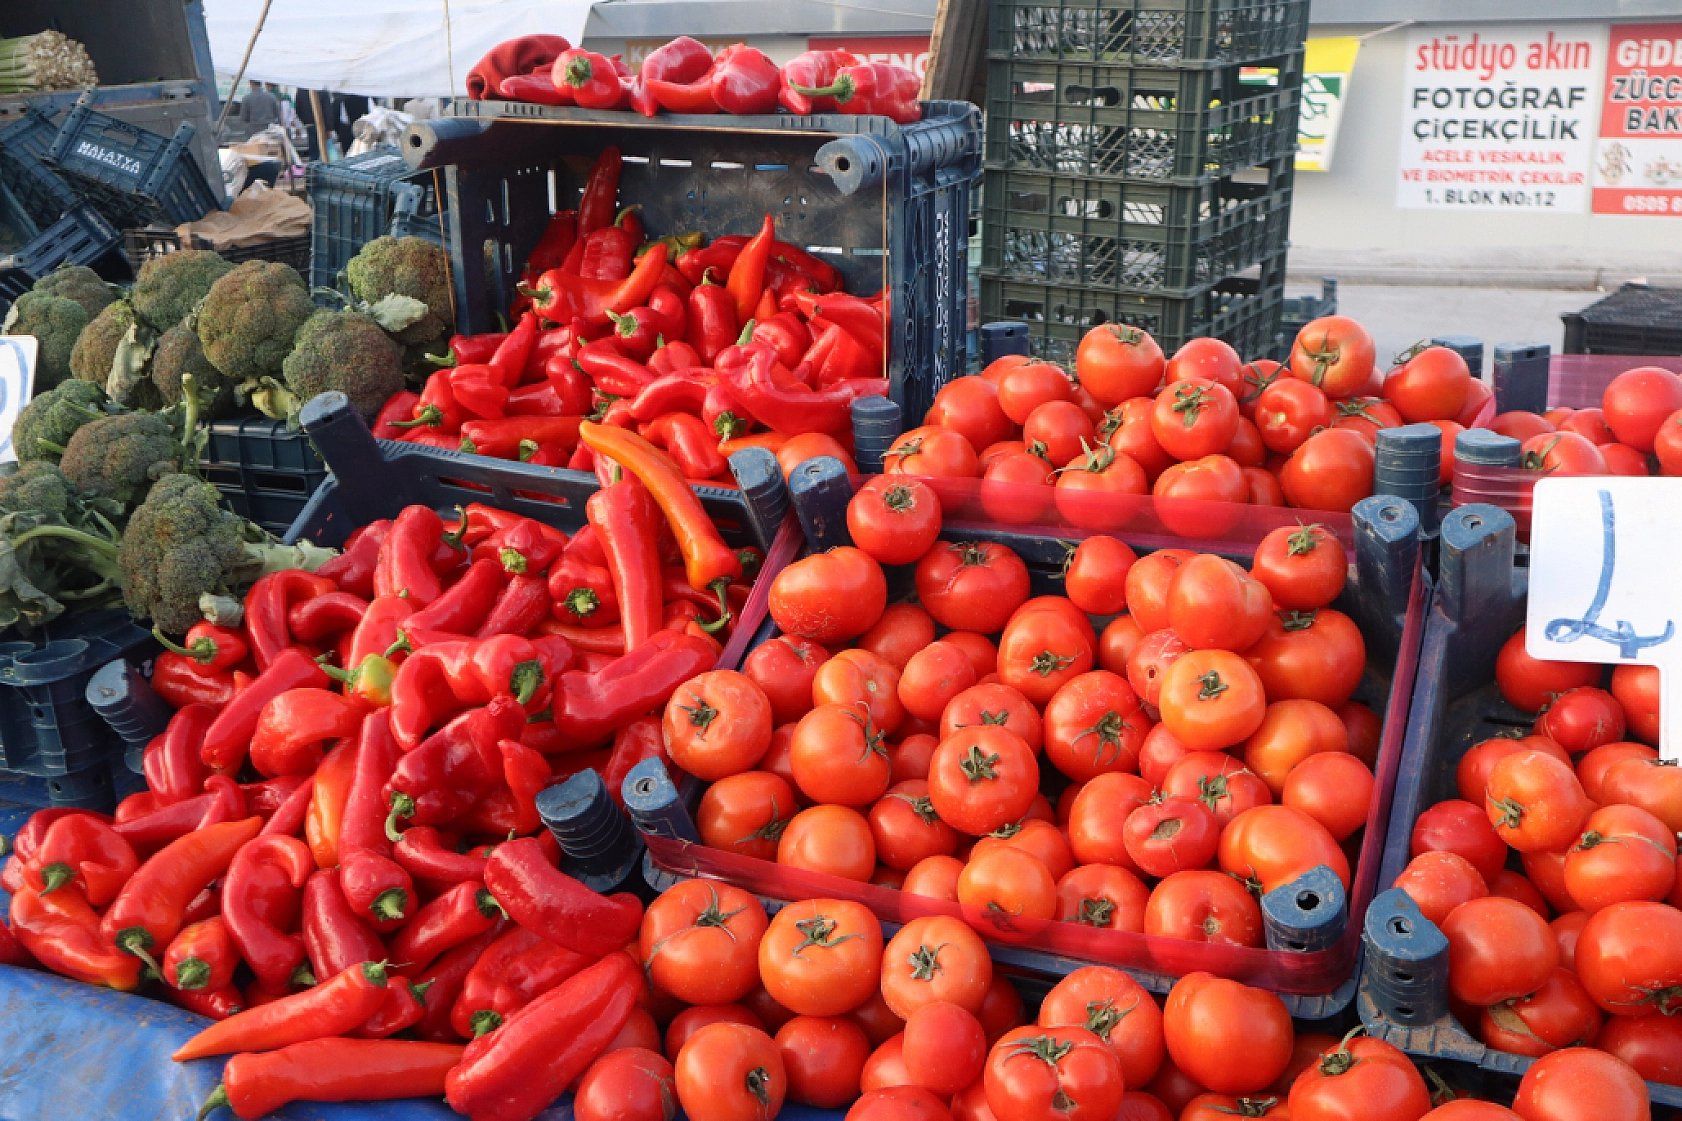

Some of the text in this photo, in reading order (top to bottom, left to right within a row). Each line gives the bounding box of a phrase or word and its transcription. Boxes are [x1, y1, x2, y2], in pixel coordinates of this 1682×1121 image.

[1412, 80, 1587, 109] FOTOĞRAF
[1422, 149, 1474, 163] ACELE
[1401, 169, 1422, 182] VE
[1444, 189, 1494, 205] BLOK
[1499, 190, 1556, 206] NO:12
